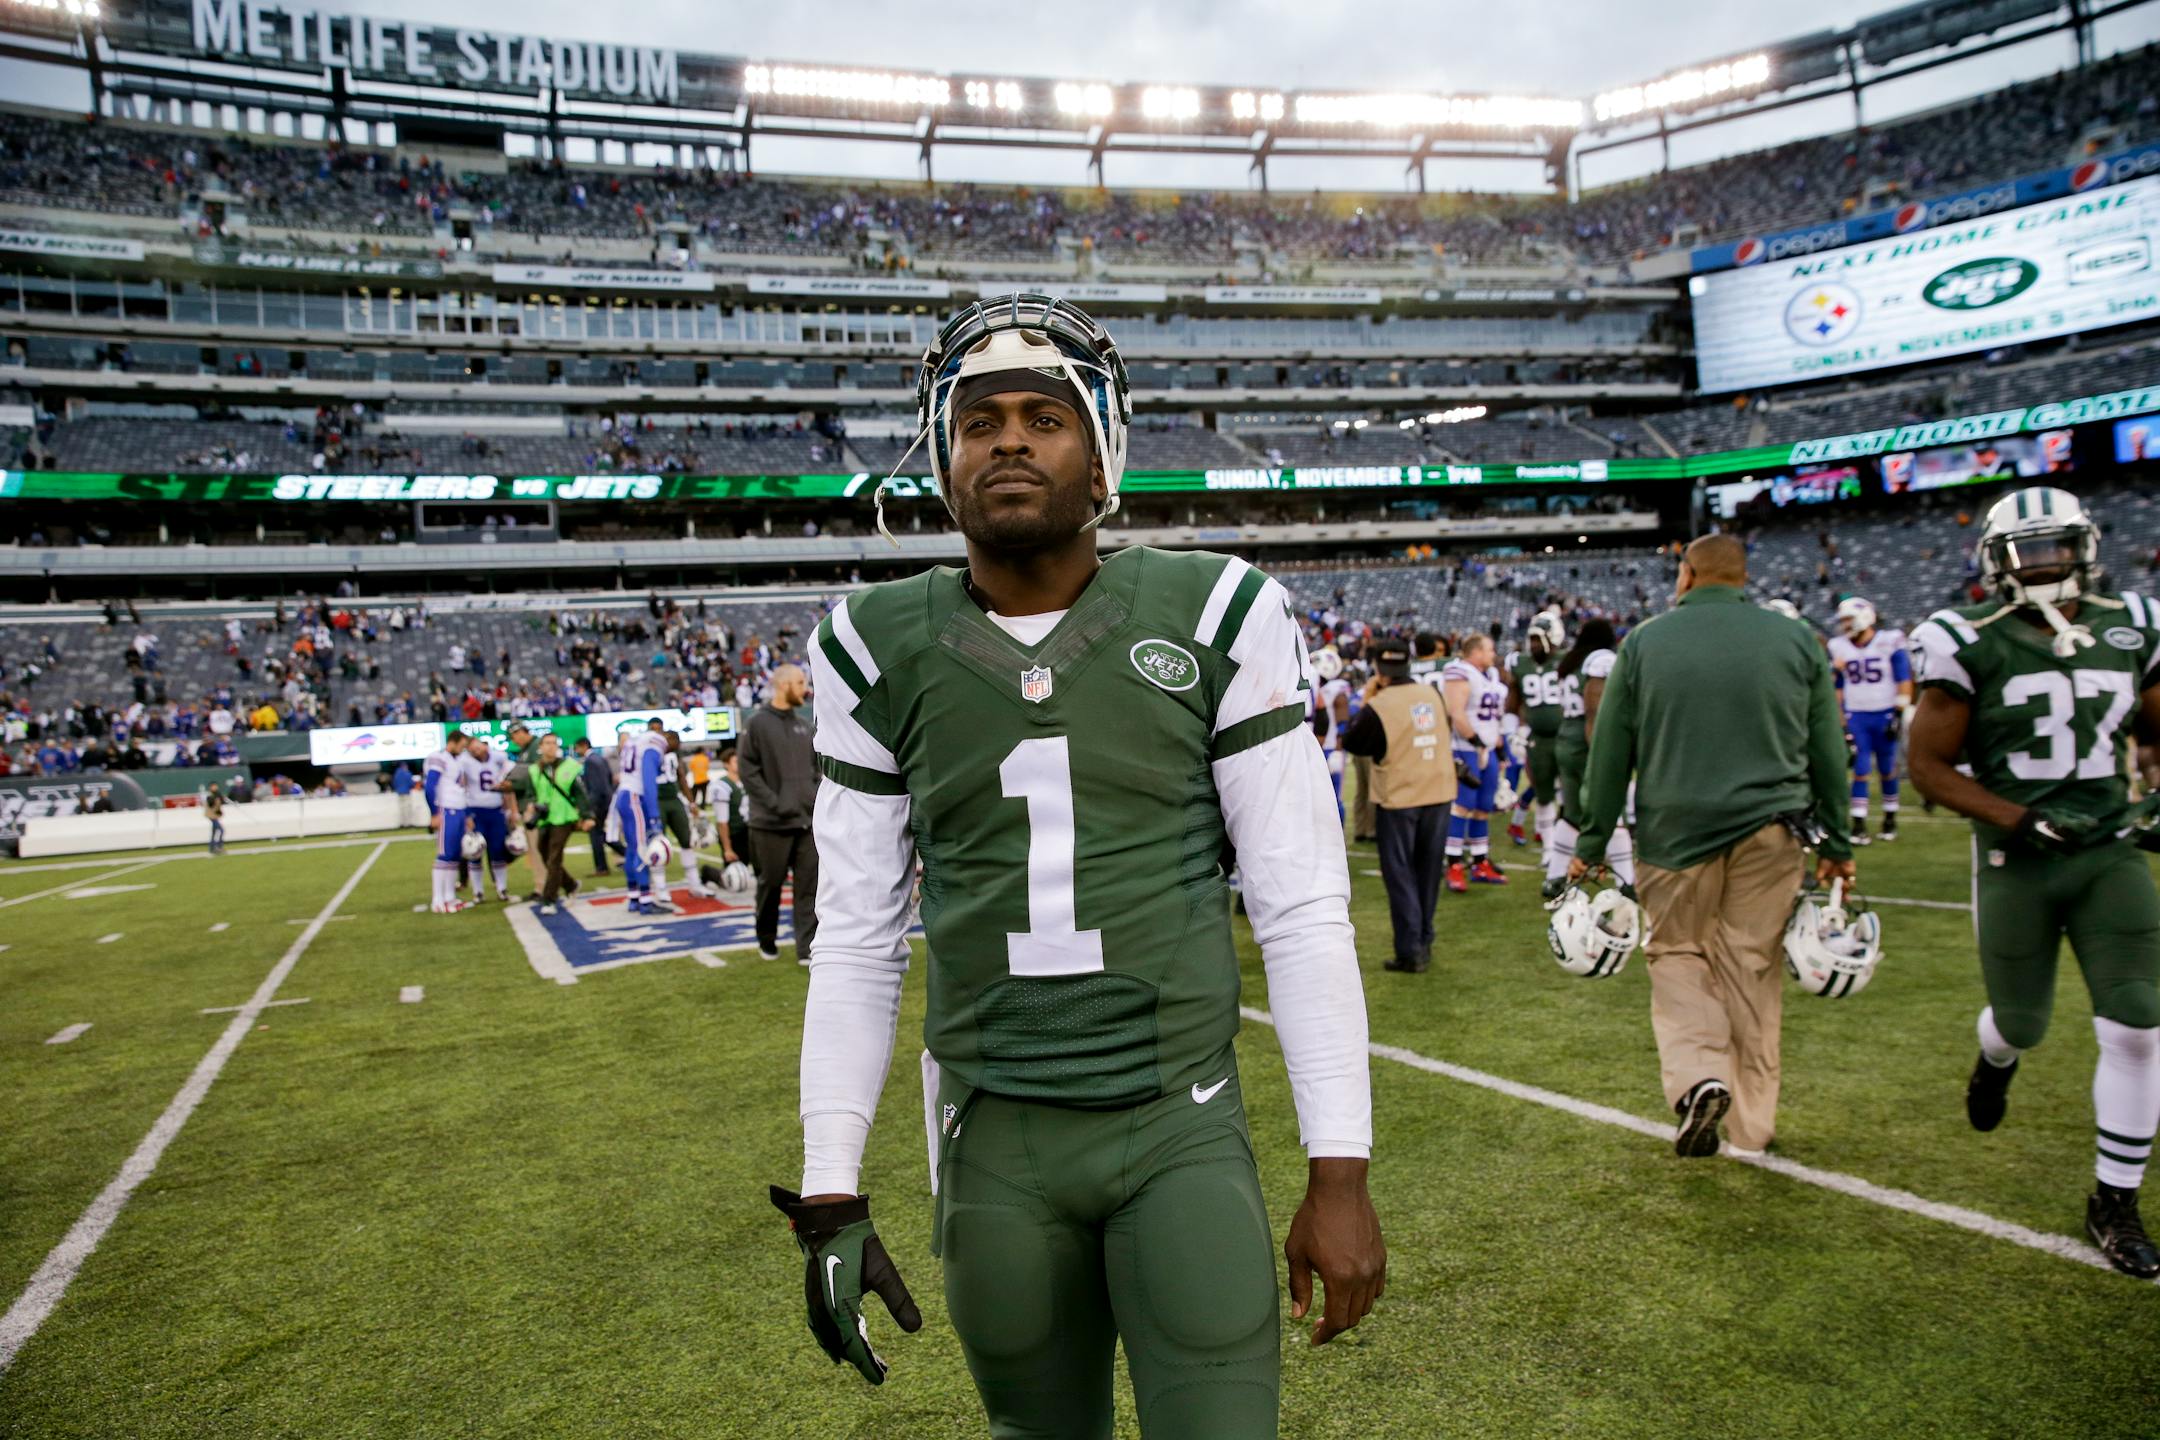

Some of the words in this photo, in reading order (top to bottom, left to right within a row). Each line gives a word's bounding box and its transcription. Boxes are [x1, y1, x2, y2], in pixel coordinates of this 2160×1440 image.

[192, 0, 437, 77] METLIFE
[455, 29, 679, 104] STADIUM
[1927, 182, 2016, 226] pepsi
[0, 235, 38, 247] AN
[1768, 222, 1847, 262] pepsi
[1791, 251, 1877, 279] NEXT
[1889, 222, 2001, 259] HOME
[2016, 186, 2141, 230] GAME
[1791, 430, 1894, 463] NEXT
[1895, 411, 2026, 447] HOME
[272, 474, 498, 500] STEELERS
[512, 478, 548, 496] vs
[556, 475, 663, 499] JETS
[1204, 468, 1290, 490] SUNDAY,
[1294, 466, 1403, 488] NOVEMBER
[1143, 653, 1187, 675] JETS
[1846, 657, 1883, 685] 85
[1522, 670, 1561, 707] 96
[2002, 668, 2136, 781] 37
[998, 735, 1104, 976] 1
